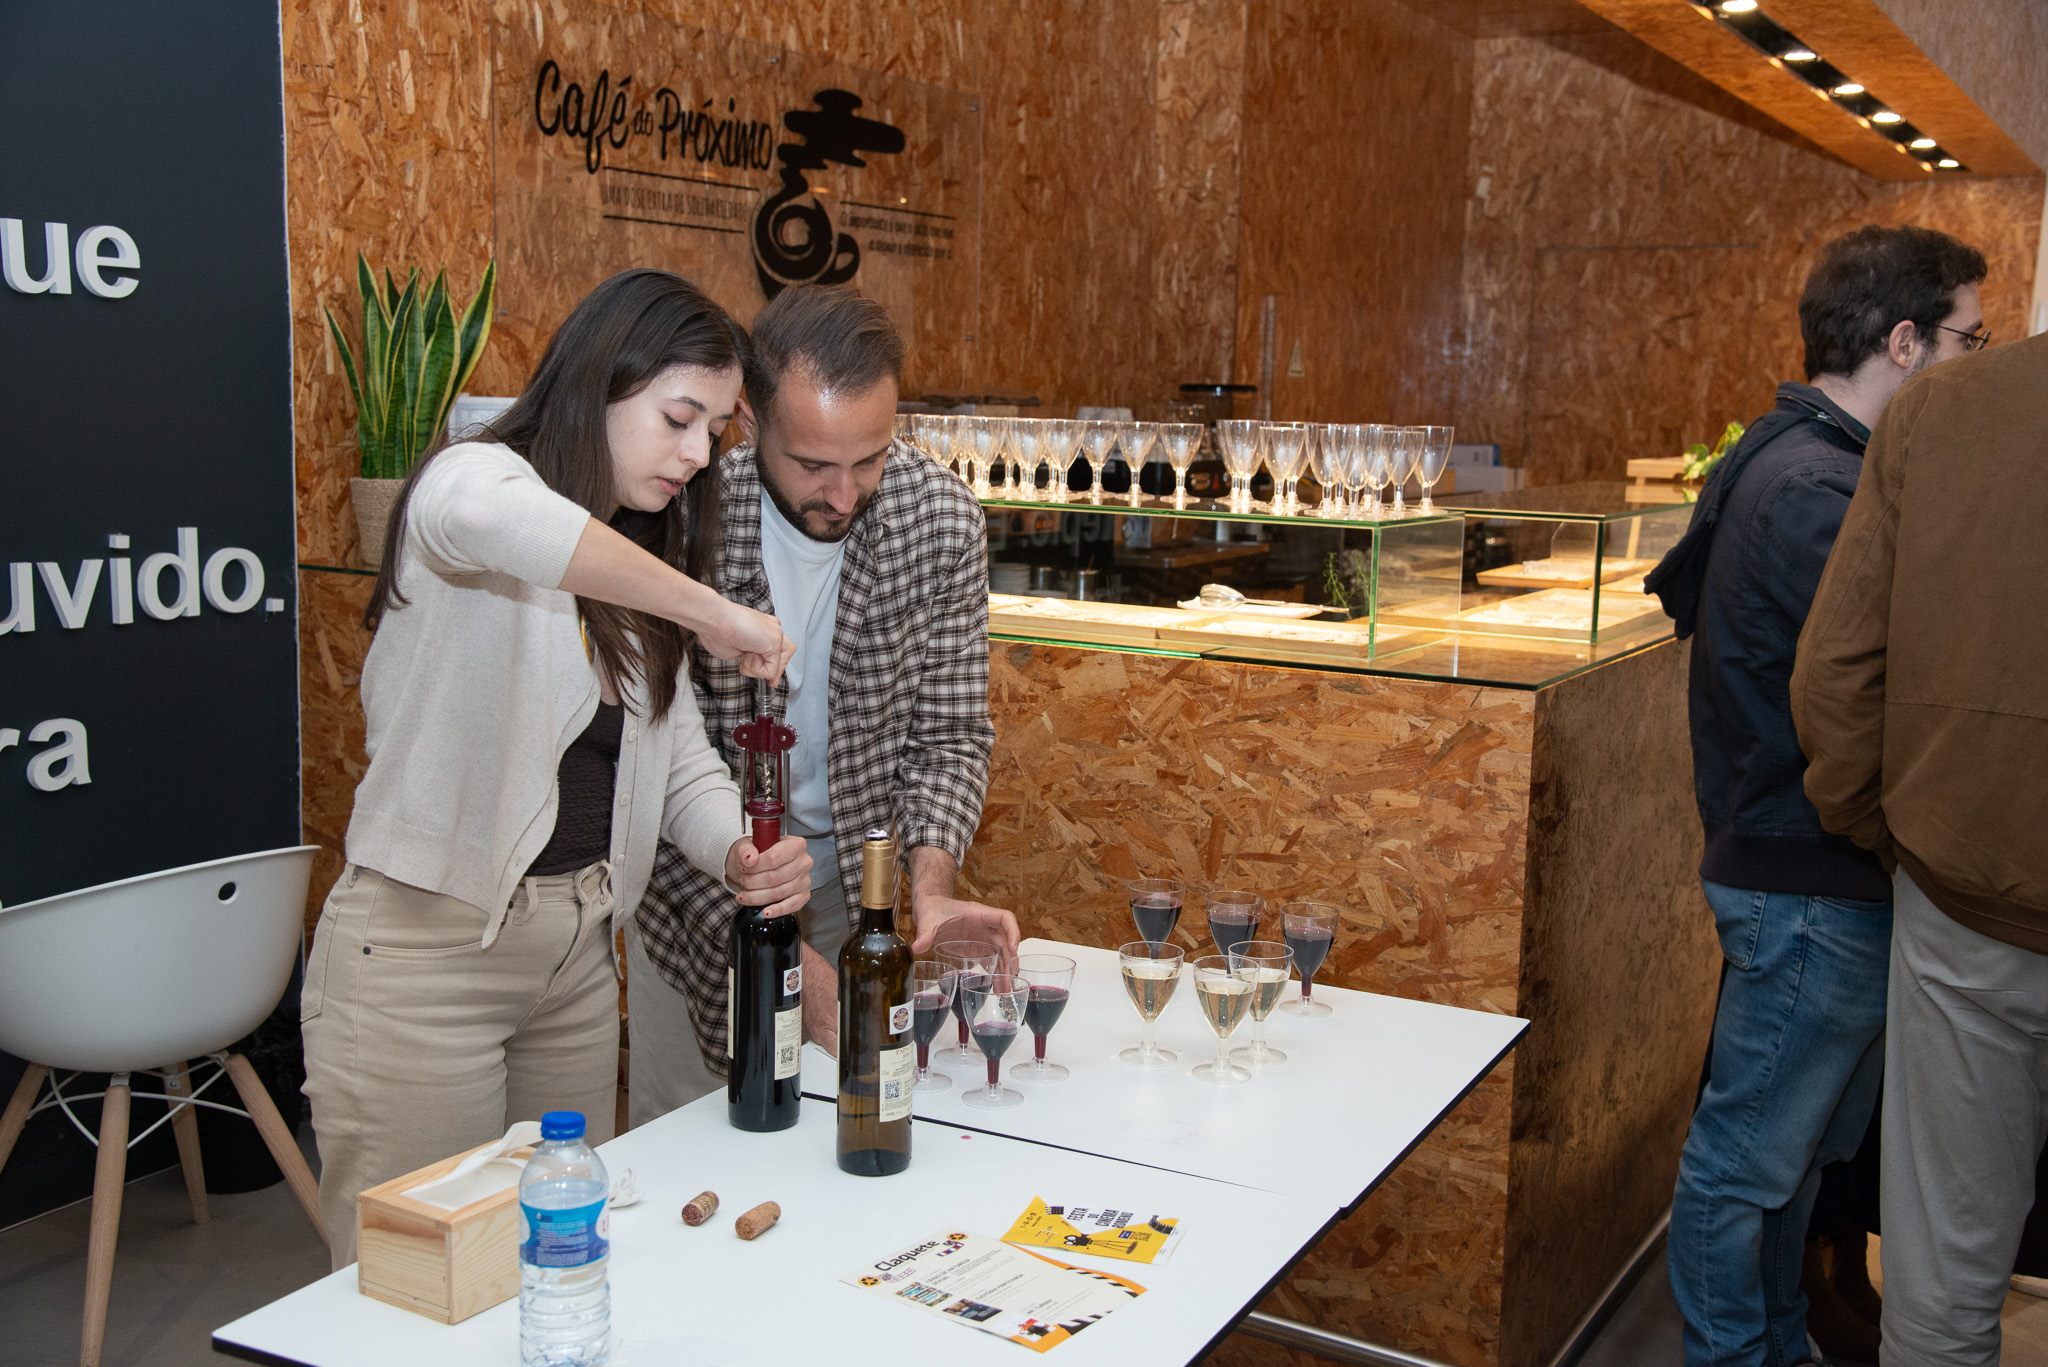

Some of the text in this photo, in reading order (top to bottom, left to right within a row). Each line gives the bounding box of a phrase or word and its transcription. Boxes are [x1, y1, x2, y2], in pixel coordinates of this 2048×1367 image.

[536, 60, 773, 174] Café do Próximo
[874, 1240, 940, 1271] Claquete
